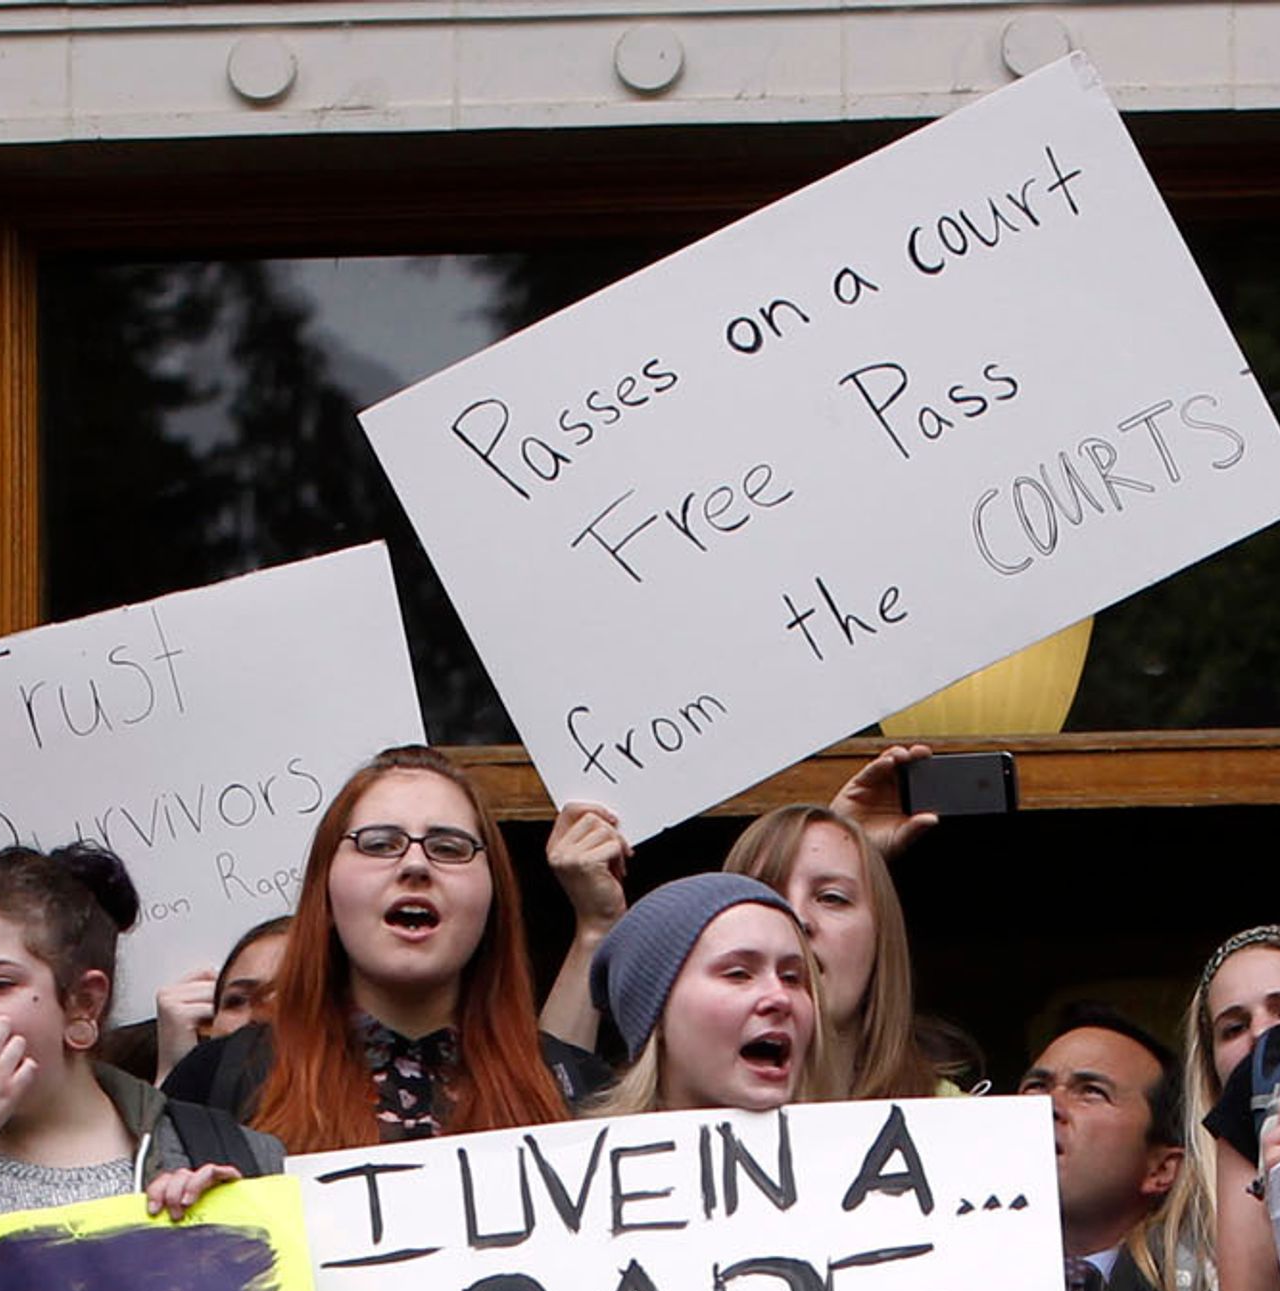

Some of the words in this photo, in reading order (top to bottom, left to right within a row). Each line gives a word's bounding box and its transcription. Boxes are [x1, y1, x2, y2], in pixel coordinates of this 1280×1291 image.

[451, 356, 678, 500] Passes
[725, 296, 810, 354] on
[832, 265, 879, 304] a
[907, 145, 1082, 275] court
[564, 691, 728, 785] from
[783, 577, 907, 660] the
[971, 394, 1246, 577] COURTS
[570, 462, 795, 582] Free
[839, 361, 1019, 460] Pass
[316, 1161, 445, 1268] I
